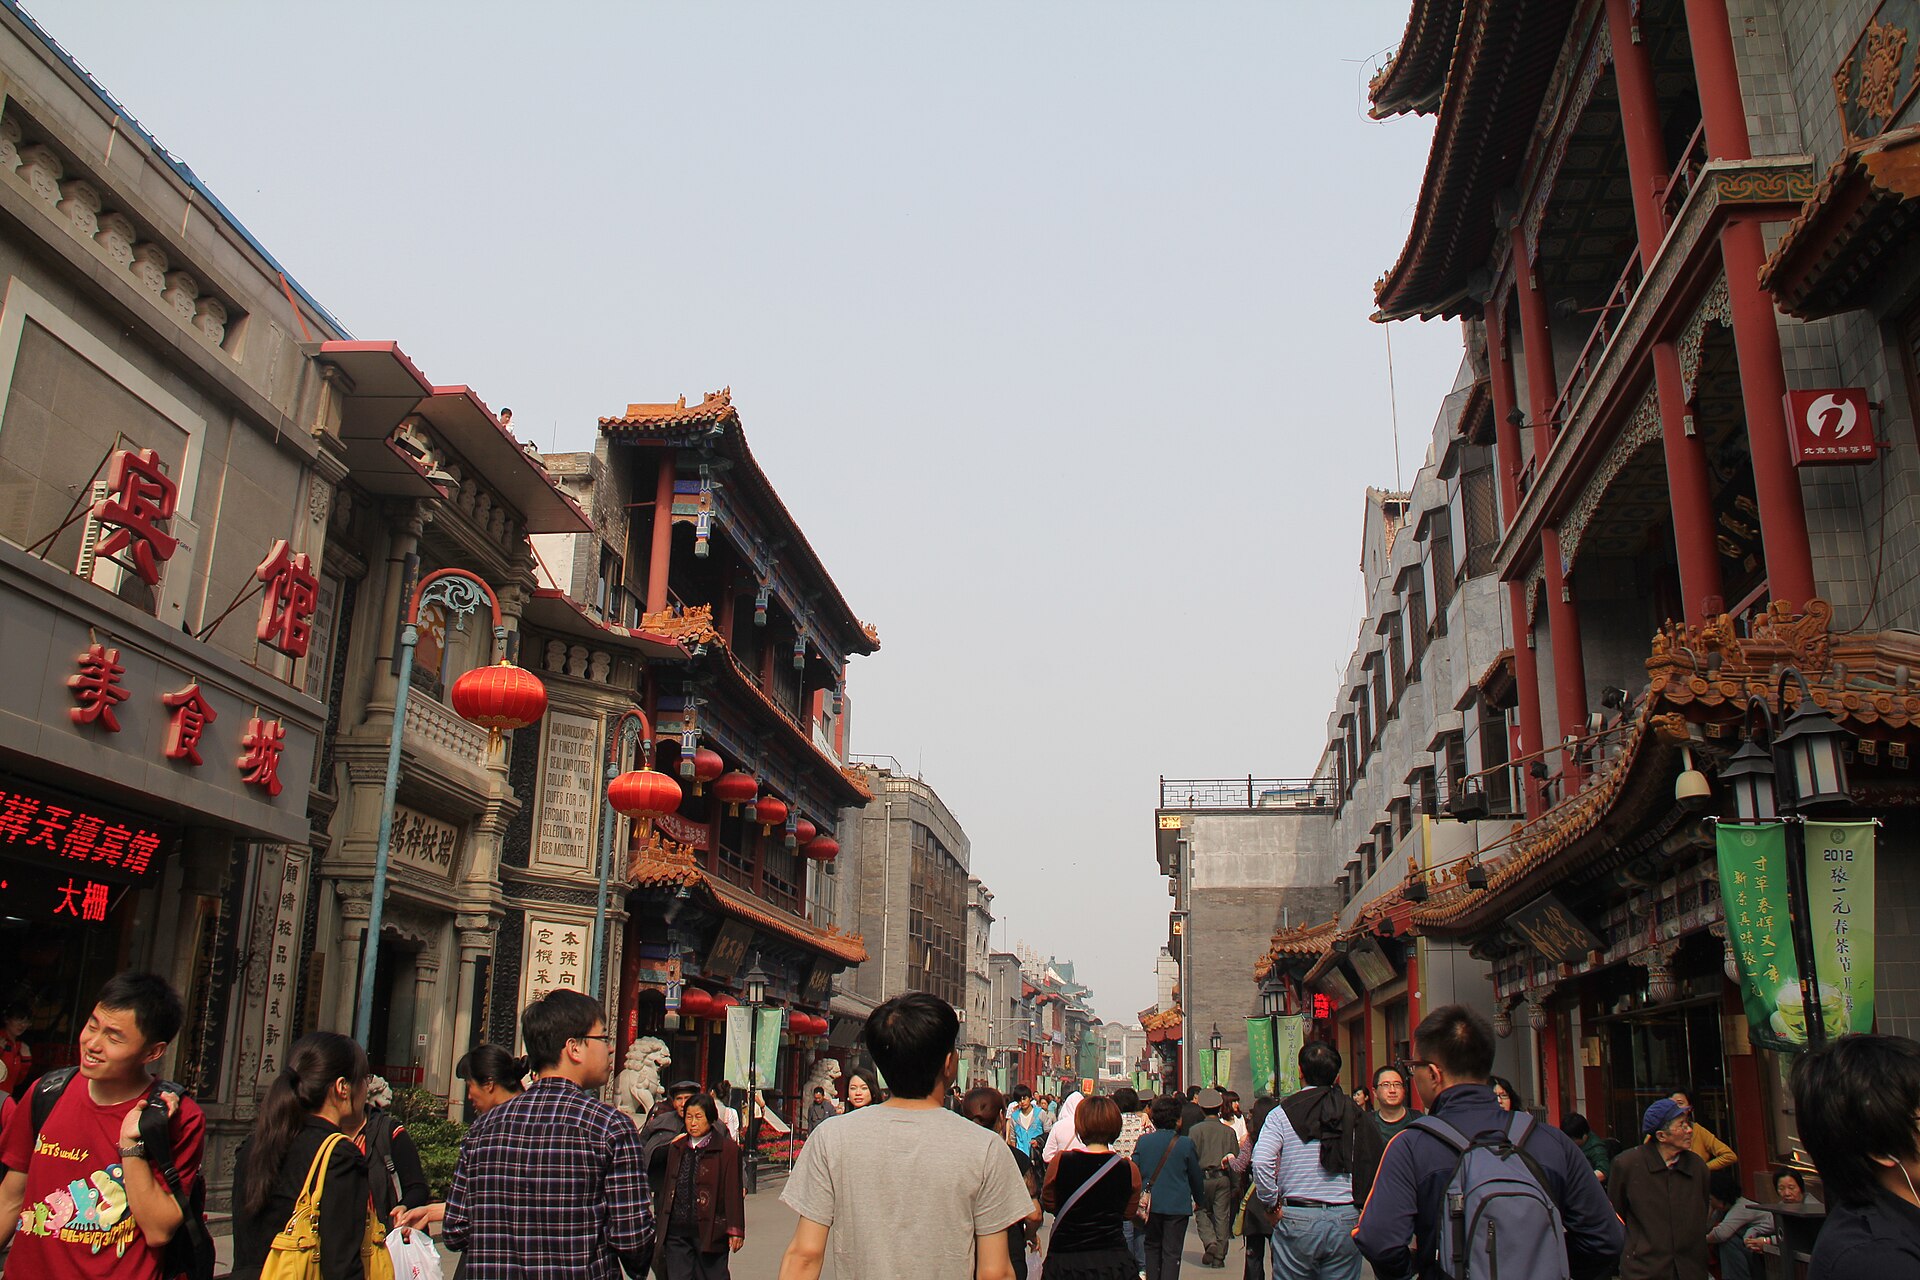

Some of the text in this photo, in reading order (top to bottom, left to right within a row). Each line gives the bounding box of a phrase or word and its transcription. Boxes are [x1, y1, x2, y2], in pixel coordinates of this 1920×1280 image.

[94, 448, 319, 658] 宾馆
[68, 644, 285, 797] 美食城
[551, 739, 557, 751] OF
[559, 740, 577, 755] FINEST
[574, 760, 590, 773] OTTER
[566, 793, 576, 805] FOR
[543, 824, 572, 839] SELECTION
[1823, 850, 1853, 862] 2012
